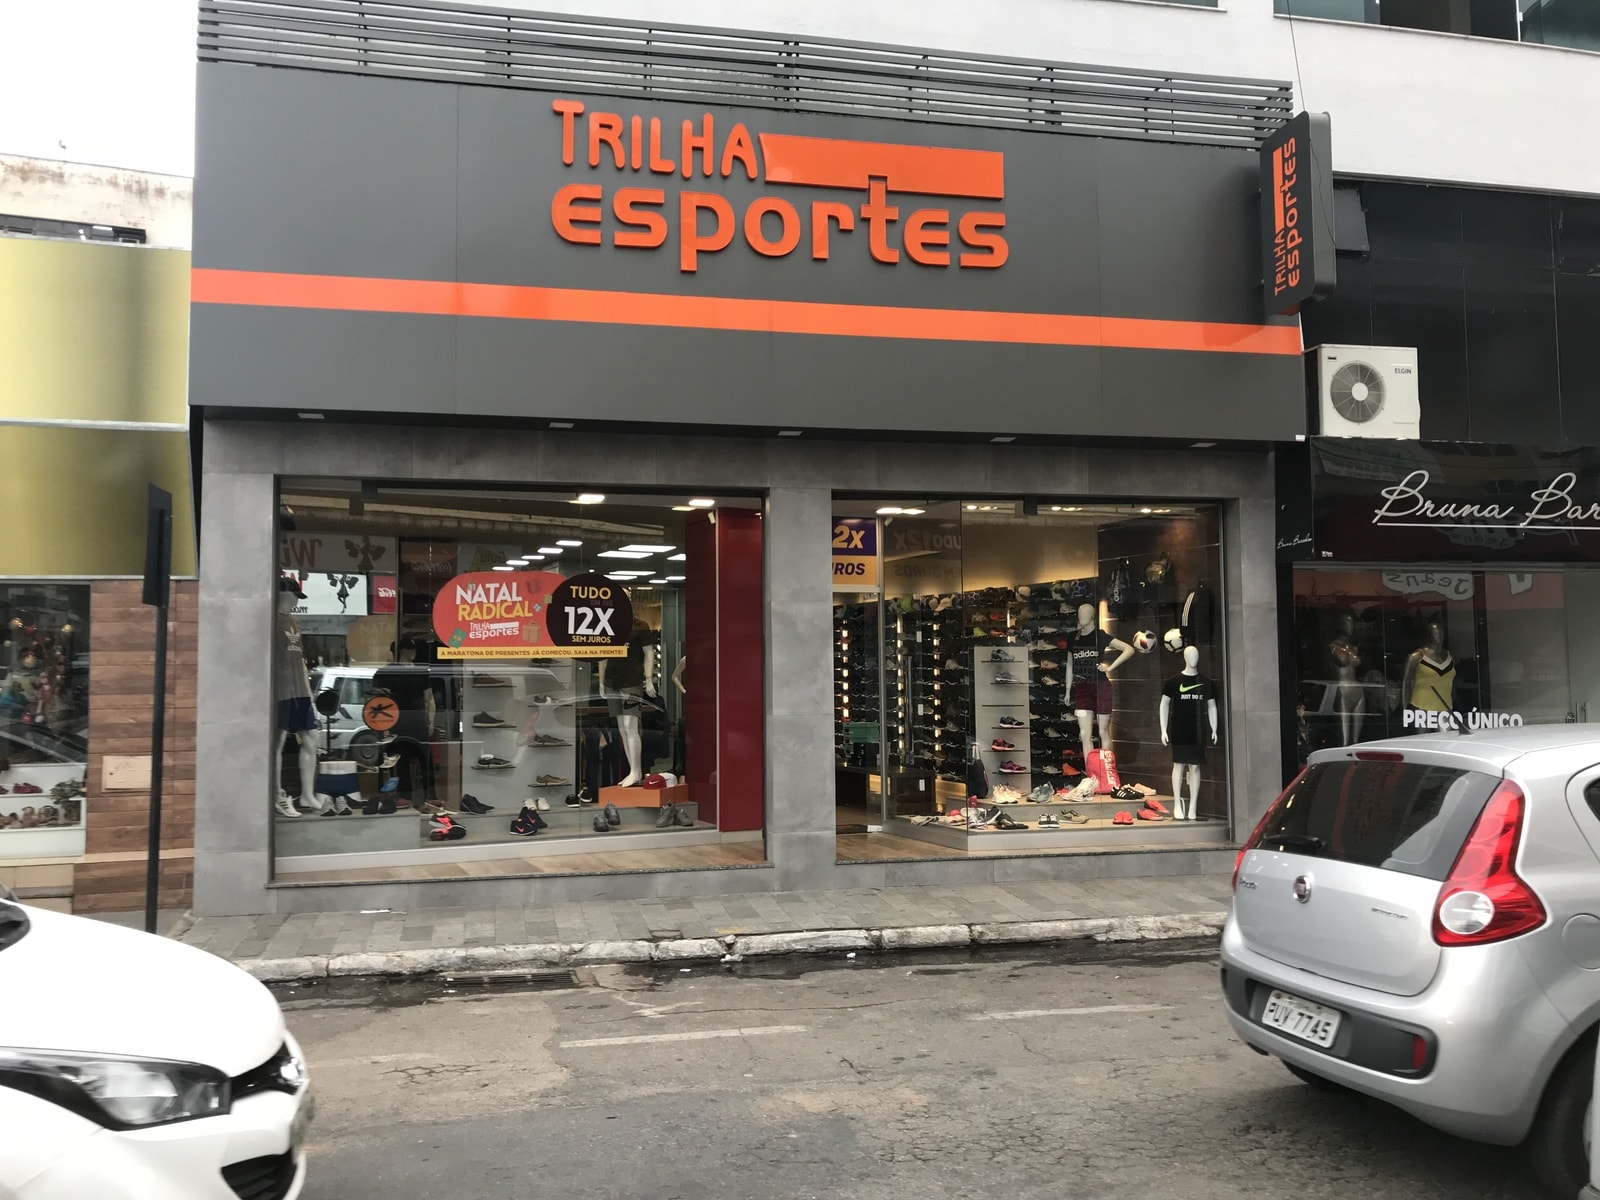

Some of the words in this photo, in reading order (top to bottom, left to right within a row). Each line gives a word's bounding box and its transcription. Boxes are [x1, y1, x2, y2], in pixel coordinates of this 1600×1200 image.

[552, 99, 758, 179] TRILHA
[274, 229, 287, 296] TRILHA
[1394, 367, 1412, 375] ELGIN
[1372, 470, 1515, 523] Bruna
[832, 562, 865, 575] ROS
[456, 582, 523, 605] NATAL
[570, 585, 612, 600] TUDO
[458, 601, 533, 621] RADICAL
[564, 606, 615, 636] 12X
[469, 621, 490, 632] TRILHA
[572, 635, 586, 643] SEM
[1403, 709, 1463, 732] PREÇO
[1468, 707, 1523, 730] ÚNICO
